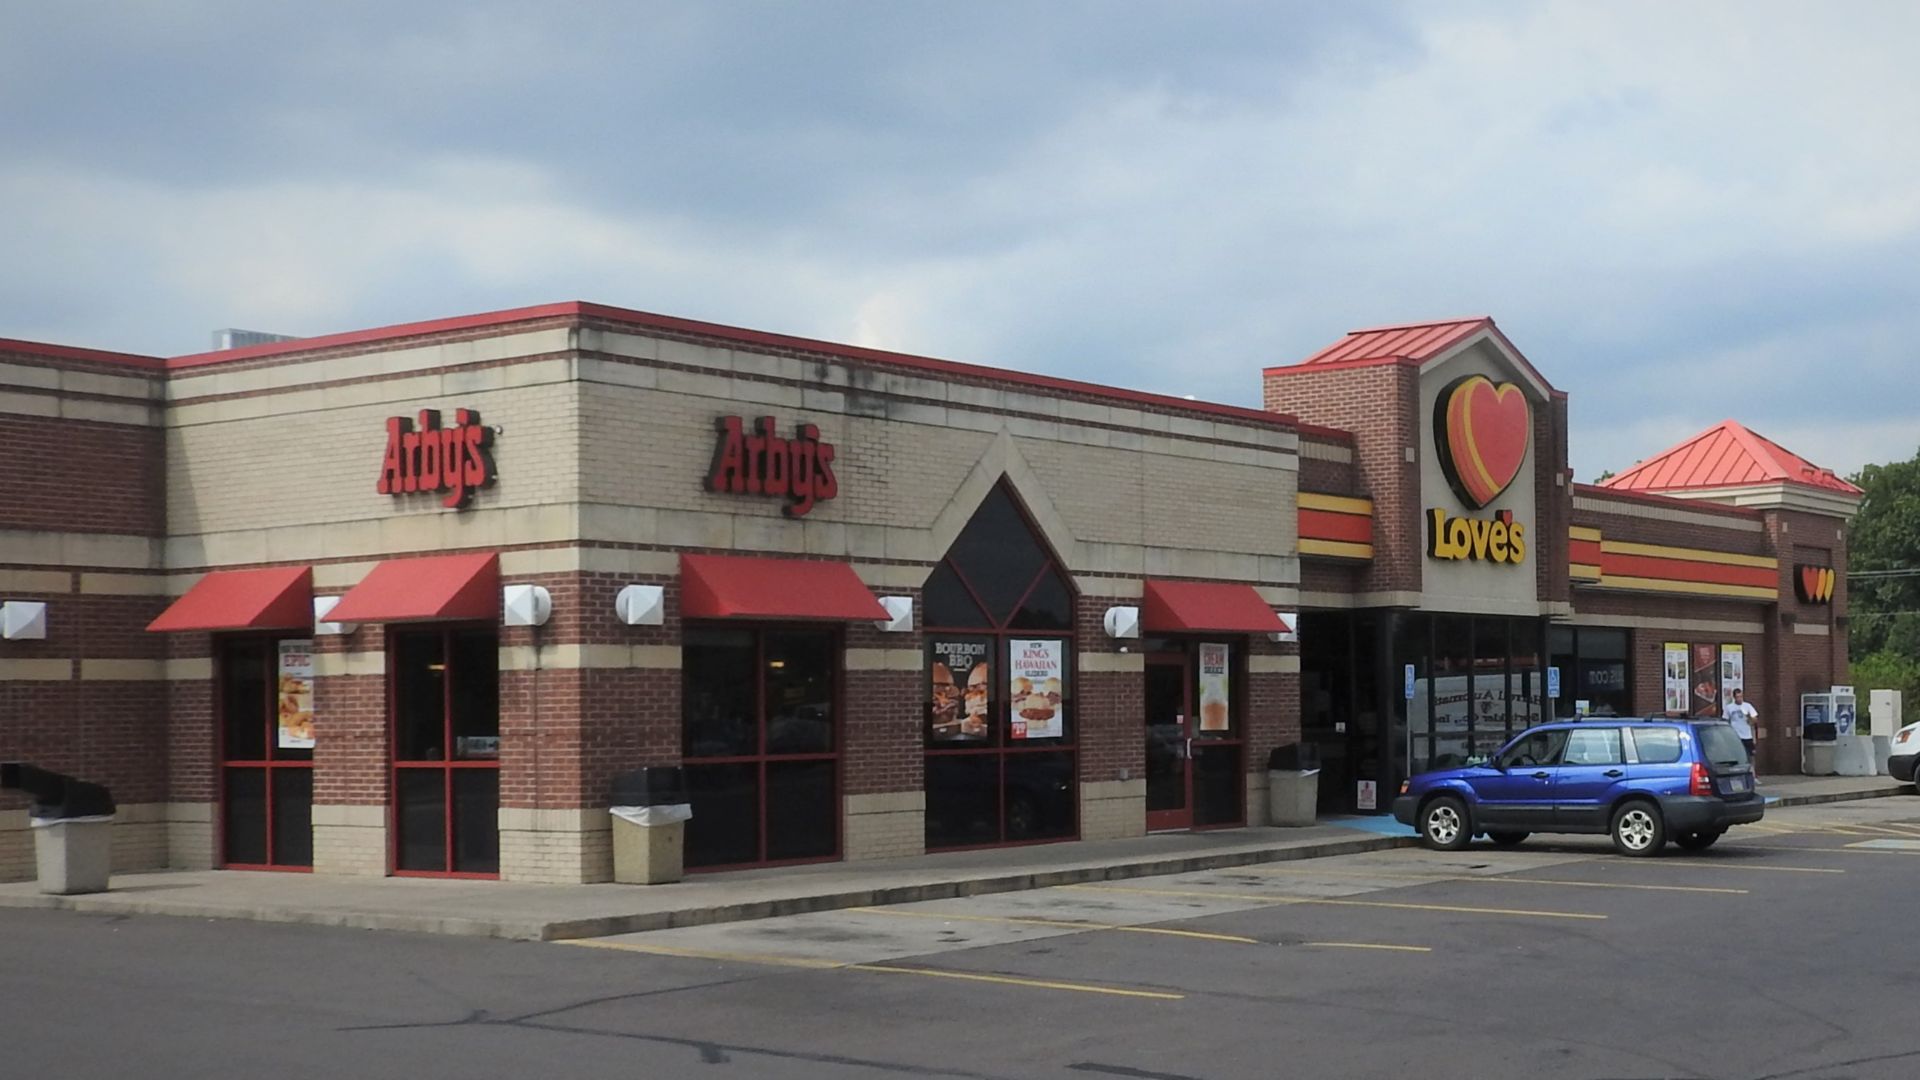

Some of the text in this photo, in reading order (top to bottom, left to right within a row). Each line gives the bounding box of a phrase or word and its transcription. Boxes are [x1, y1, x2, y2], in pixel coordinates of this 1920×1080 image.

[377, 408, 489, 508] Arby's
[708, 415, 837, 515] Arby's
[1430, 508, 1526, 563] Love's
[935, 642, 986, 655] BOURBON
[949, 654, 973, 668] BBQ
